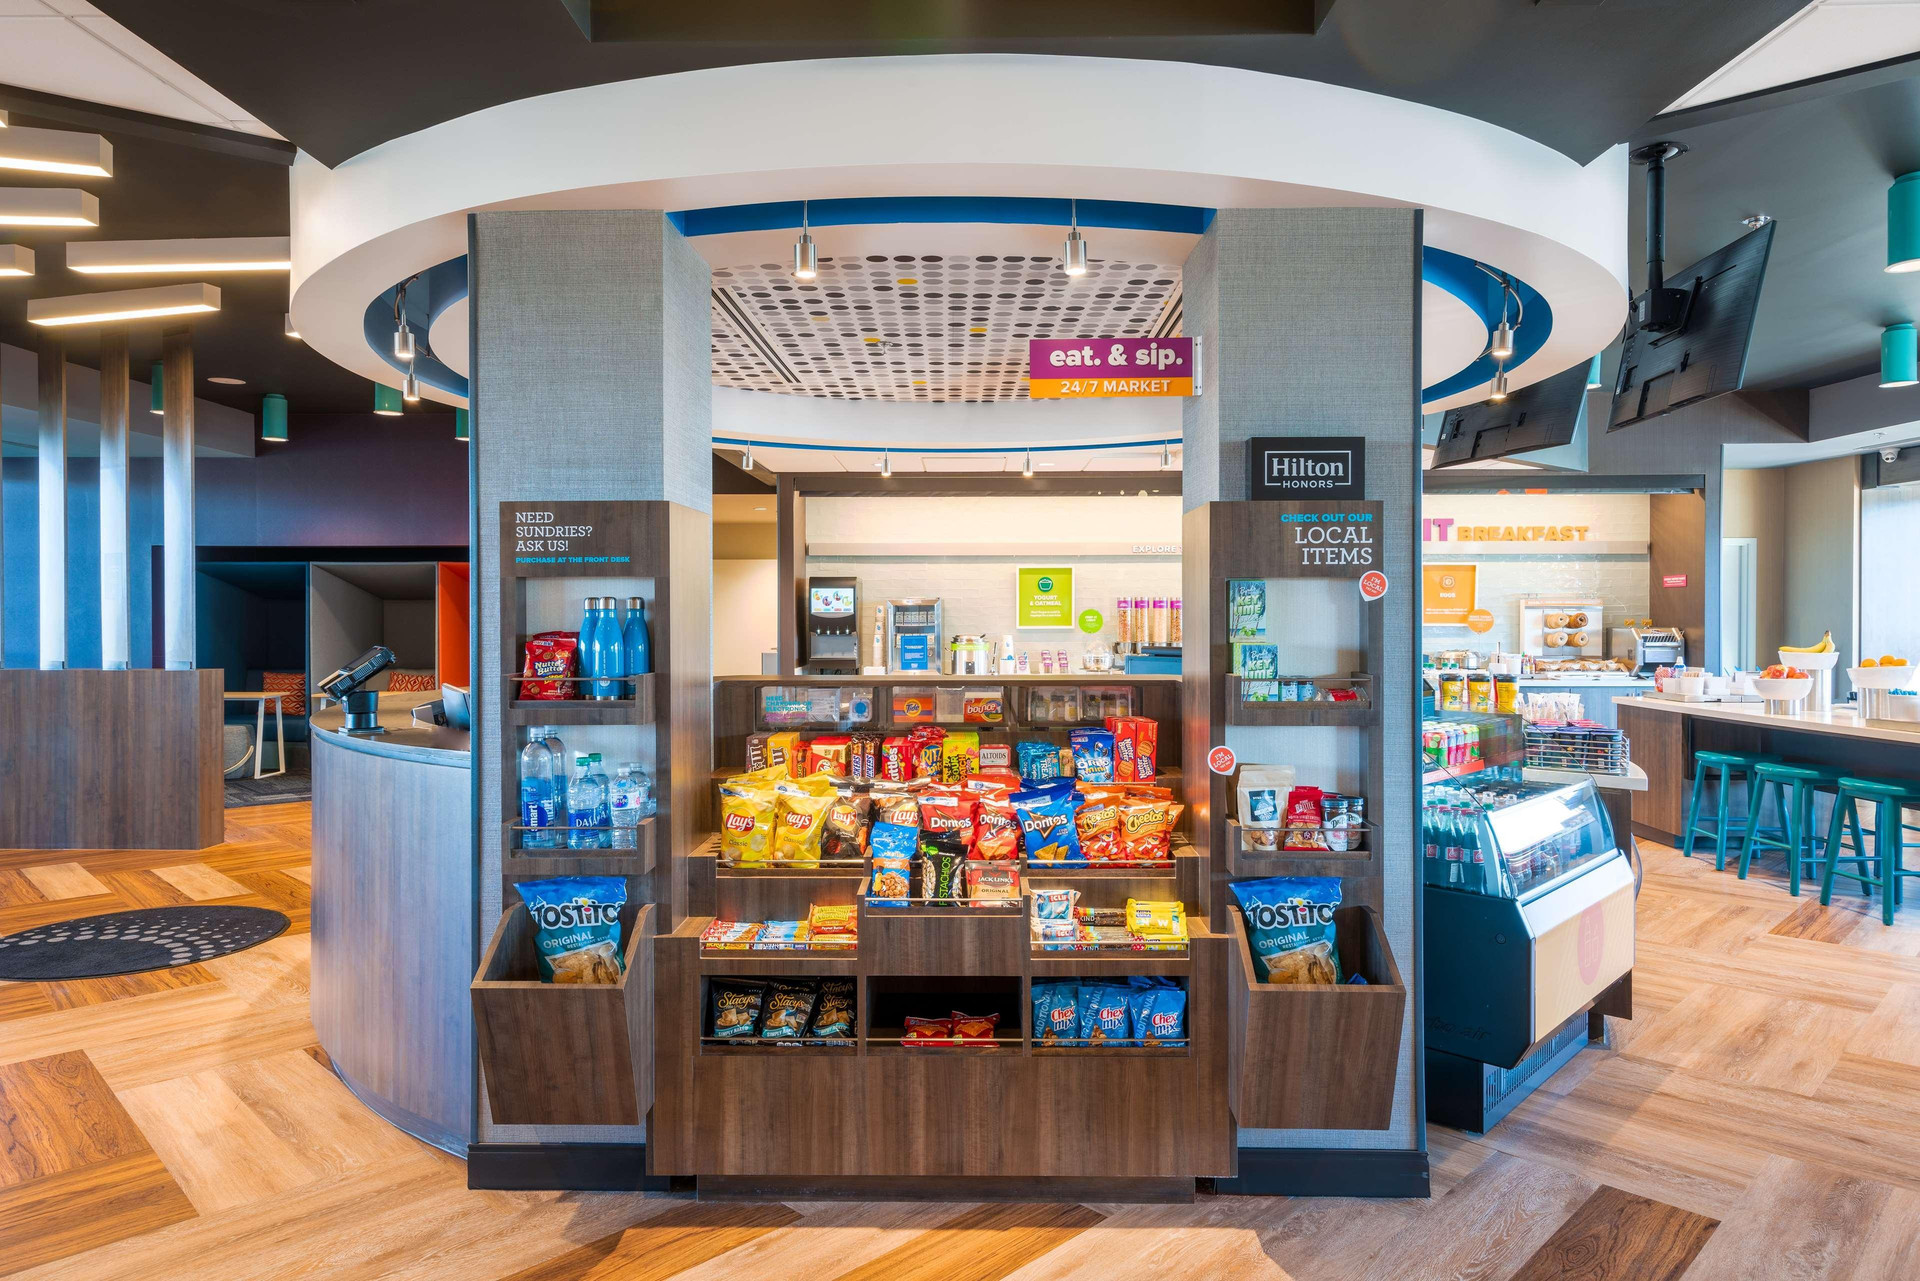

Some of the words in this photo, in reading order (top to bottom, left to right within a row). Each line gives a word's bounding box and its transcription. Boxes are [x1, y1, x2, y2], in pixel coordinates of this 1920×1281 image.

[1050, 345, 1101, 366] eat.
[1108, 343, 1128, 366] &
[1135, 342, 1183, 370] sip.
[1060, 380, 1098, 393] 24/7
[1103, 379, 1170, 392] MARKET
[1272, 457, 1344, 477] Hilton
[1282, 480, 1333, 488] HONORS
[515, 512, 554, 523] NEED
[1281, 513, 1319, 522] CHECK
[1321, 513, 1345, 522] OUT
[1348, 513, 1373, 522] OUR
[515, 526, 593, 537] SUNDRIES?
[1295, 526, 1373, 544] LOCAL
[1457, 525, 1589, 541] BREAKFAST
[515, 540, 544, 552] ASK
[547, 540, 569, 551] US!
[1132, 545, 1177, 553] EXPLORE
[1302, 547, 1372, 565] ITEMS
[1363, 579, 1383, 592] LOCAL
[1237, 594, 1260, 606] KEY
[1234, 604, 1263, 615] LIME
[1248, 659, 1272, 670] KEY
[906, 704, 920, 713] Tide
[967, 703, 996, 714] bounce
[981, 752, 1007, 760] ALTOIDS
[1213, 754, 1232, 768] LOCAL
[727, 812, 754, 832] Lay's
[832, 809, 856, 826] Lay's
[892, 810, 918, 824] Lay's
[930, 816, 972, 829] Doritos
[980, 813, 1018, 830] Doritos
[1024, 813, 1069, 833] Doritos
[1081, 807, 1116, 832] Cheetos
[1126, 809, 1165, 834] Cheetos
[938, 856, 952, 906] PSTACHIOS
[543, 931, 594, 949] ORIGINAL
[1258, 931, 1310, 949] ORIGINAL
[718, 991, 755, 1009] Stacy's
[769, 992, 804, 1010] Stacy's
[1035, 989, 1053, 1038] RADITIONAL
[1051, 1006, 1075, 1021] Chex
[1100, 1006, 1125, 1020] Chex
[1152, 1012, 1177, 1026] Chex
[1054, 1017, 1075, 1032] mix
[1102, 1017, 1124, 1030] mix
[1155, 1023, 1177, 1036] mix
